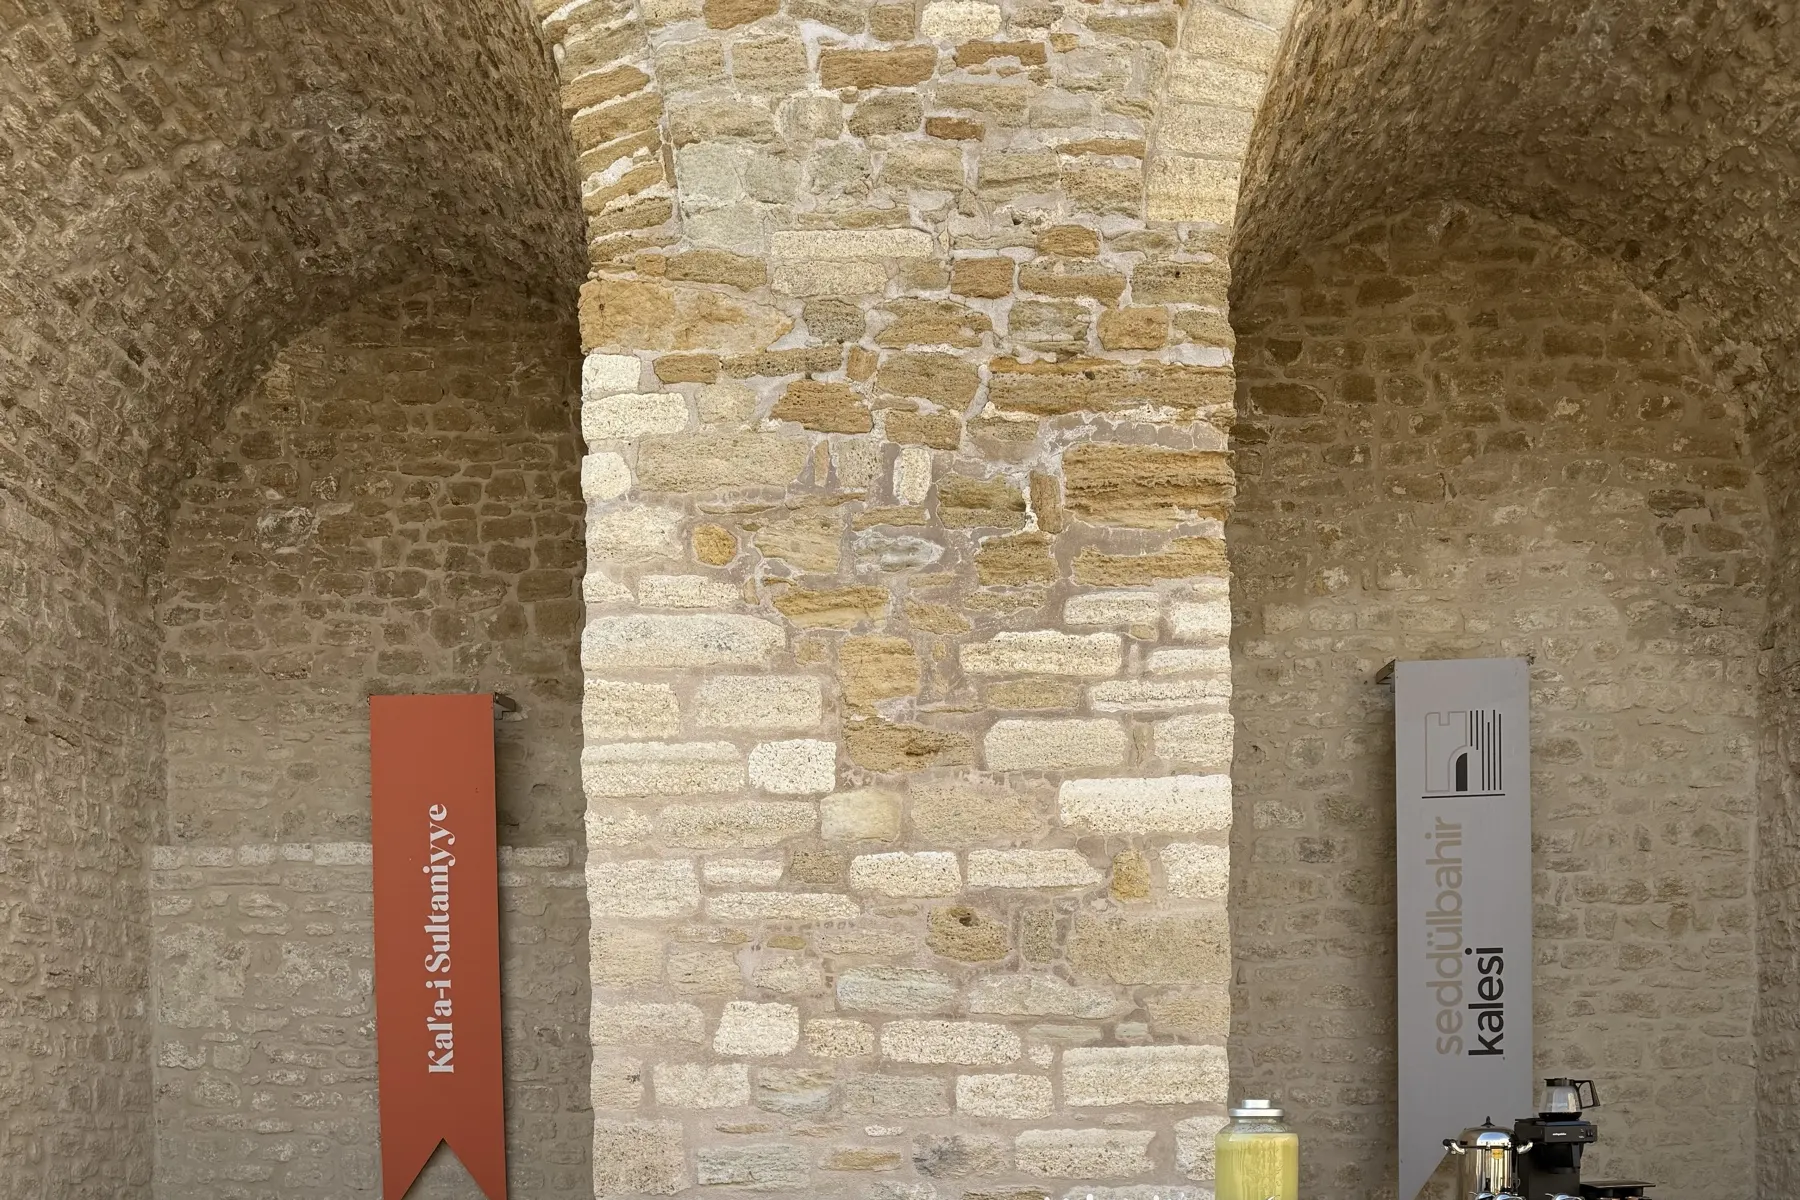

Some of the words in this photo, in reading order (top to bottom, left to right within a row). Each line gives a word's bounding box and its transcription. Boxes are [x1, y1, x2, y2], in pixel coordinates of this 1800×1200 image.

[422, 803, 456, 973] Sultaniyye
[1424, 815, 1464, 1056] seddülbahir
[425, 979, 455, 1074] Kal'a-i
[1464, 947, 1504, 1056] kalesi
